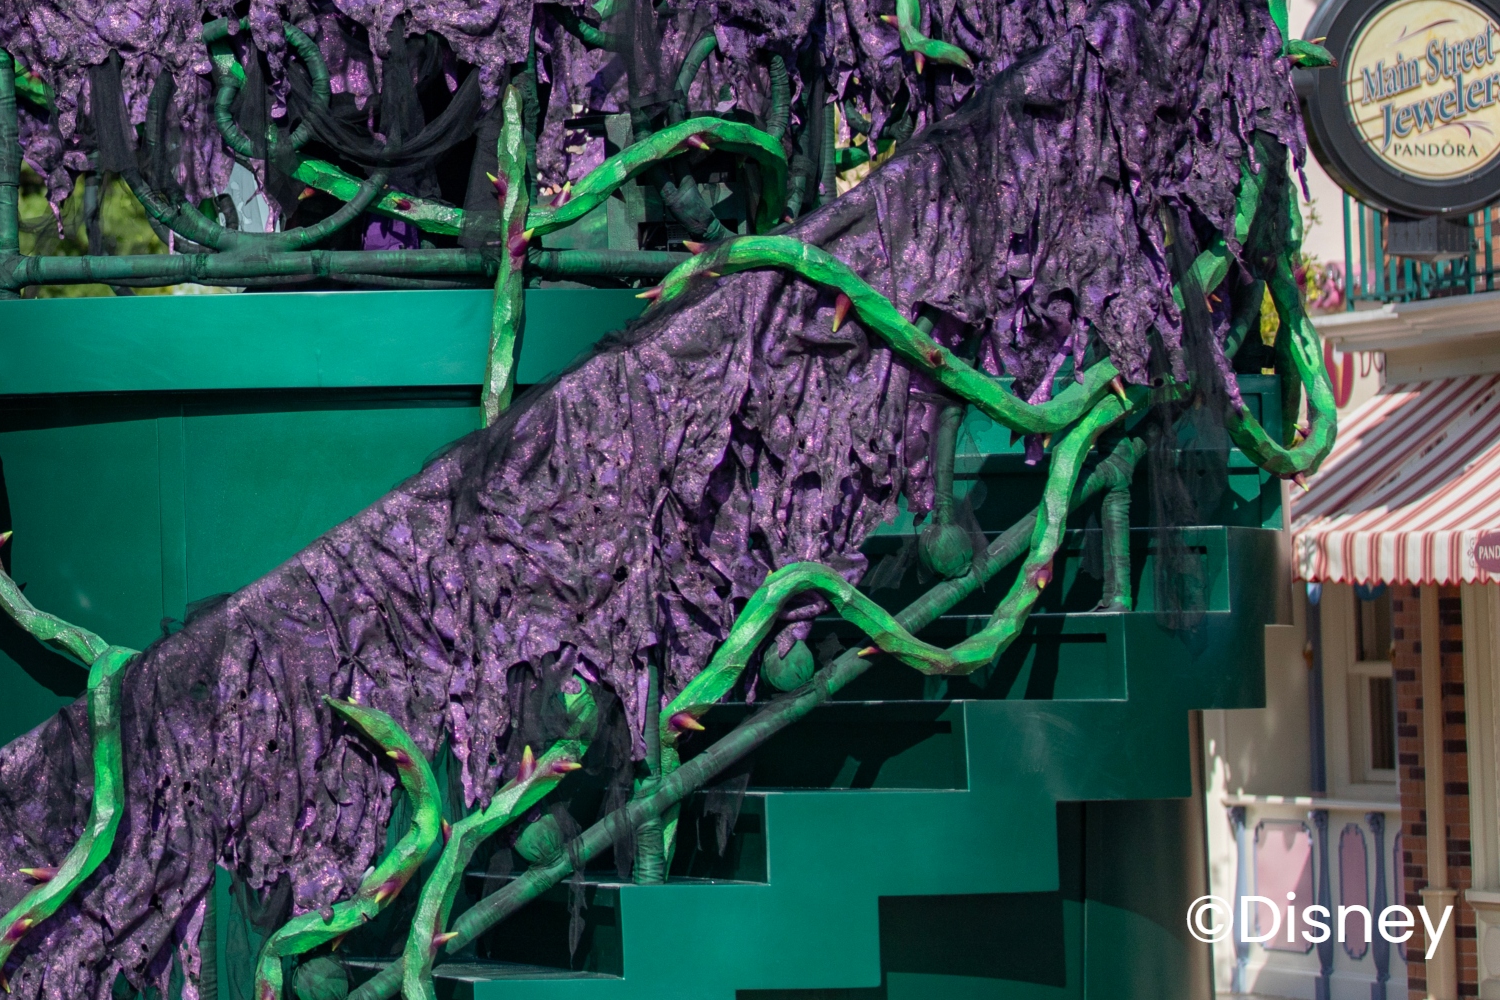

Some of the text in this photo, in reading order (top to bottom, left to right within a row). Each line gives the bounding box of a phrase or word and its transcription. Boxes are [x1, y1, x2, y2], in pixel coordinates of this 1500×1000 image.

[1361, 20, 1495, 106] Main Street
[1380, 71, 1500, 153] Jeweler
[1394, 141, 1479, 158] PANDORA
